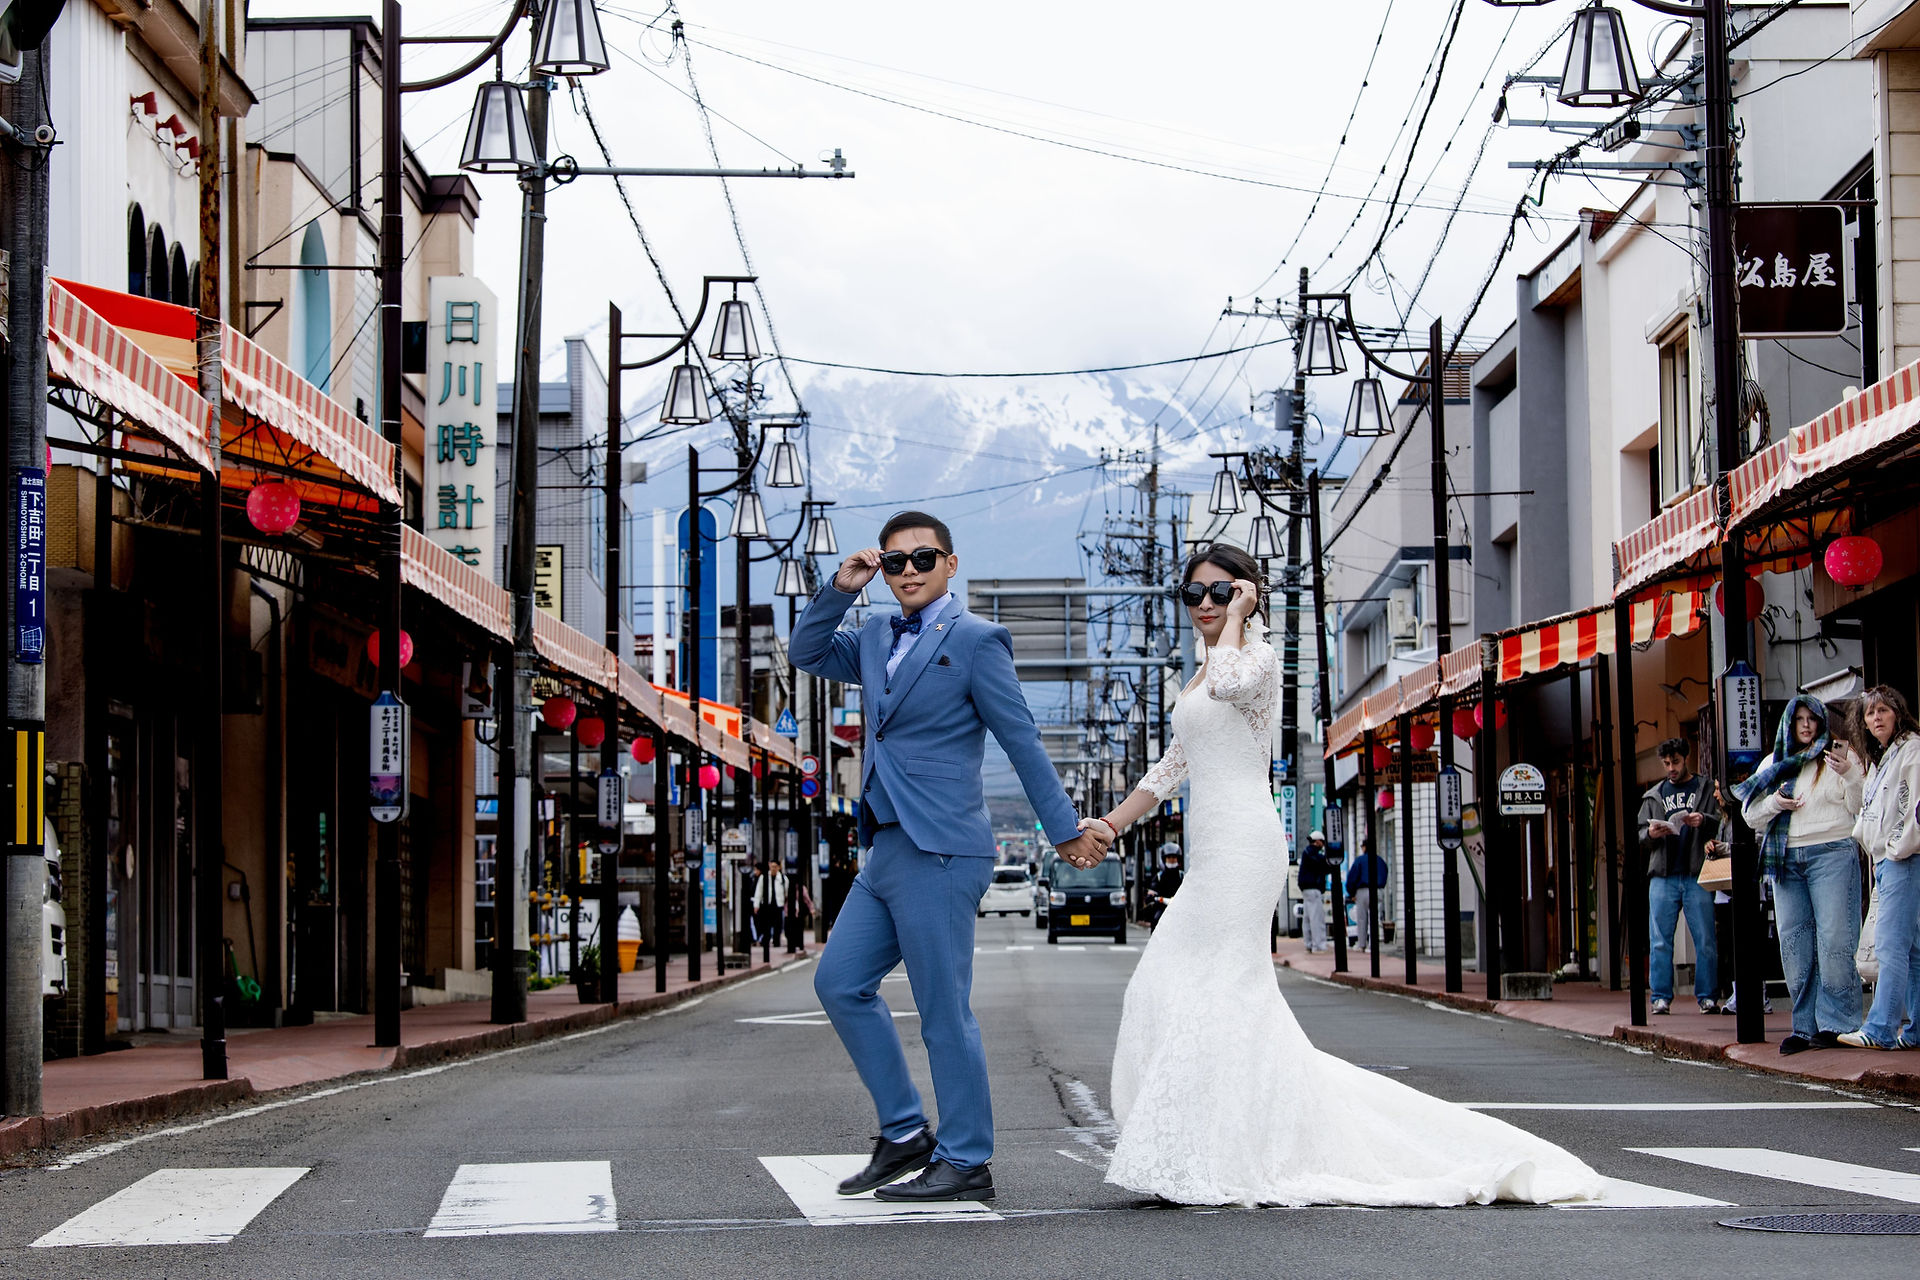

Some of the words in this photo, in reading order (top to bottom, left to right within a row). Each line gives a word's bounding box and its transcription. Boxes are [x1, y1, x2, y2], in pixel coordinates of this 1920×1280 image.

[20, 490, 28, 550] SHIMOYOSHIDA
[28, 491, 41, 591] 下吉田二丁目
[20, 553, 28, 590] 2-CHOME
[29, 598, 36, 617] 1
[1737, 677, 1749, 747] 本町二丁目商店街
[1662, 792, 1696, 813] IKEA
[560, 912, 592, 923] OEN
